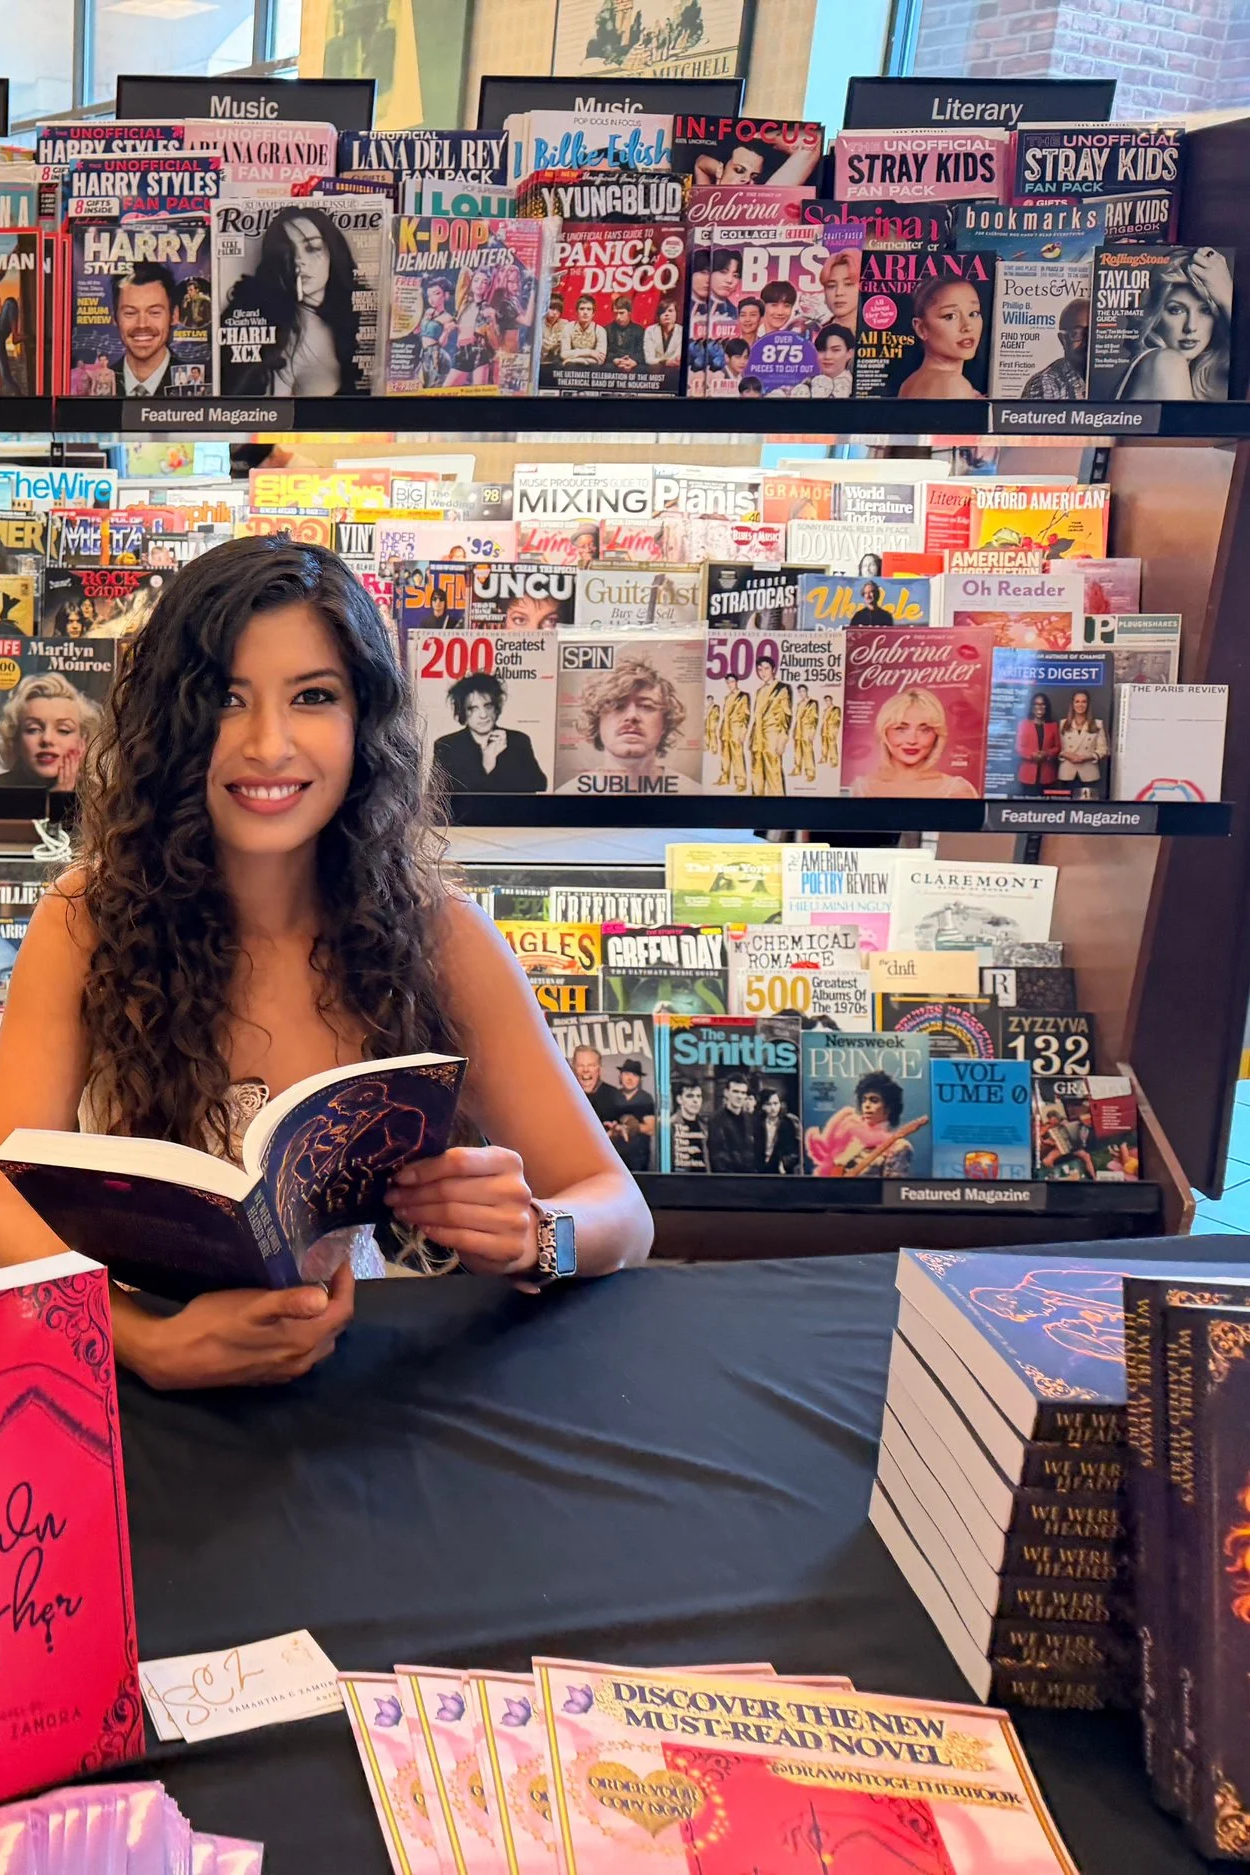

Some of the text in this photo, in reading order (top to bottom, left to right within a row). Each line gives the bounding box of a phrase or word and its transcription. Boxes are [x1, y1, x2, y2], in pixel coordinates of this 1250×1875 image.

[210, 96, 278, 118] Music
[575, 97, 643, 114] Music
[932, 99, 1023, 124] Literary
[884, 140, 996, 151] UNOFFICIAL
[1064, 135, 1180, 147] UNOFFICIAL
[104, 160, 201, 171] UNOFFICIAL
[848, 153, 996, 184] STRAY KIDS
[1024, 148, 1179, 181] STRAY KIDS
[72, 173, 218, 196] HARRY STYLES
[966, 208, 1097, 229] bookmarks
[400, 219, 489, 255] K-POP
[84, 231, 204, 264] HARRY
[85, 263, 133, 274] STYLES
[861, 254, 989, 281] ARIANA
[583, 266, 678, 294] DISCO
[1098, 270, 1150, 289] TAYLOR
[77, 298, 98, 306] NEW
[1097, 289, 1141, 308] SWIFT
[77, 306, 108, 315] ALBUM
[77, 315, 111, 324] REVIEW
[1003, 312, 1055, 326] Williams
[217, 327, 276, 345] CHARLI
[231, 345, 262, 363] XCX
[762, 345, 804, 363] 875
[141, 409, 277, 424] Featured Magazine
[1001, 409, 1142, 427] Featured Magazine
[519, 489, 647, 514] MIXING
[977, 491, 1105, 509] OXFORD AMERICAN
[963, 581, 1064, 597] Oh Reader
[1118, 620, 1178, 629] PLOUGHSHARES
[28, 642, 94, 657] Marilyn
[496, 639, 545, 652] Greatest
[852, 634, 952, 665] Sabrina
[48, 657, 112, 673] Monroe
[422, 637, 493, 679] 200
[495, 653, 522, 666] Goth
[563, 647, 613, 668] SPIN
[495, 667, 537, 681] Albums
[858, 662, 981, 693] Carpenter
[1132, 685, 1227, 694] THE PARIS REVIEW
[577, 775, 678, 793] SUBLIME
[1001, 810, 1140, 826] Featured Magazine
[801, 851, 858, 872] AMERICAN
[801, 873, 888, 895] POETRY REVIEW
[911, 872, 1043, 890] CLAREMONT
[812, 977, 858, 989] Greatest
[1008, 1016, 1088, 1033] ZYZZYVA
[825, 1034, 905, 1048] Newsweek
[674, 1035, 797, 1067] Smiths
[1008, 1035, 1091, 1075] 132
[810, 1049, 924, 1079] PRINCE
[901, 1187, 1031, 1203] Featured Magazine
[612, 1682, 946, 1739] DISCOVER THE NEW
[10, 1706, 83, 1743] ZAMORA
[624, 1708, 952, 1766] MUST-READ NOVEL
